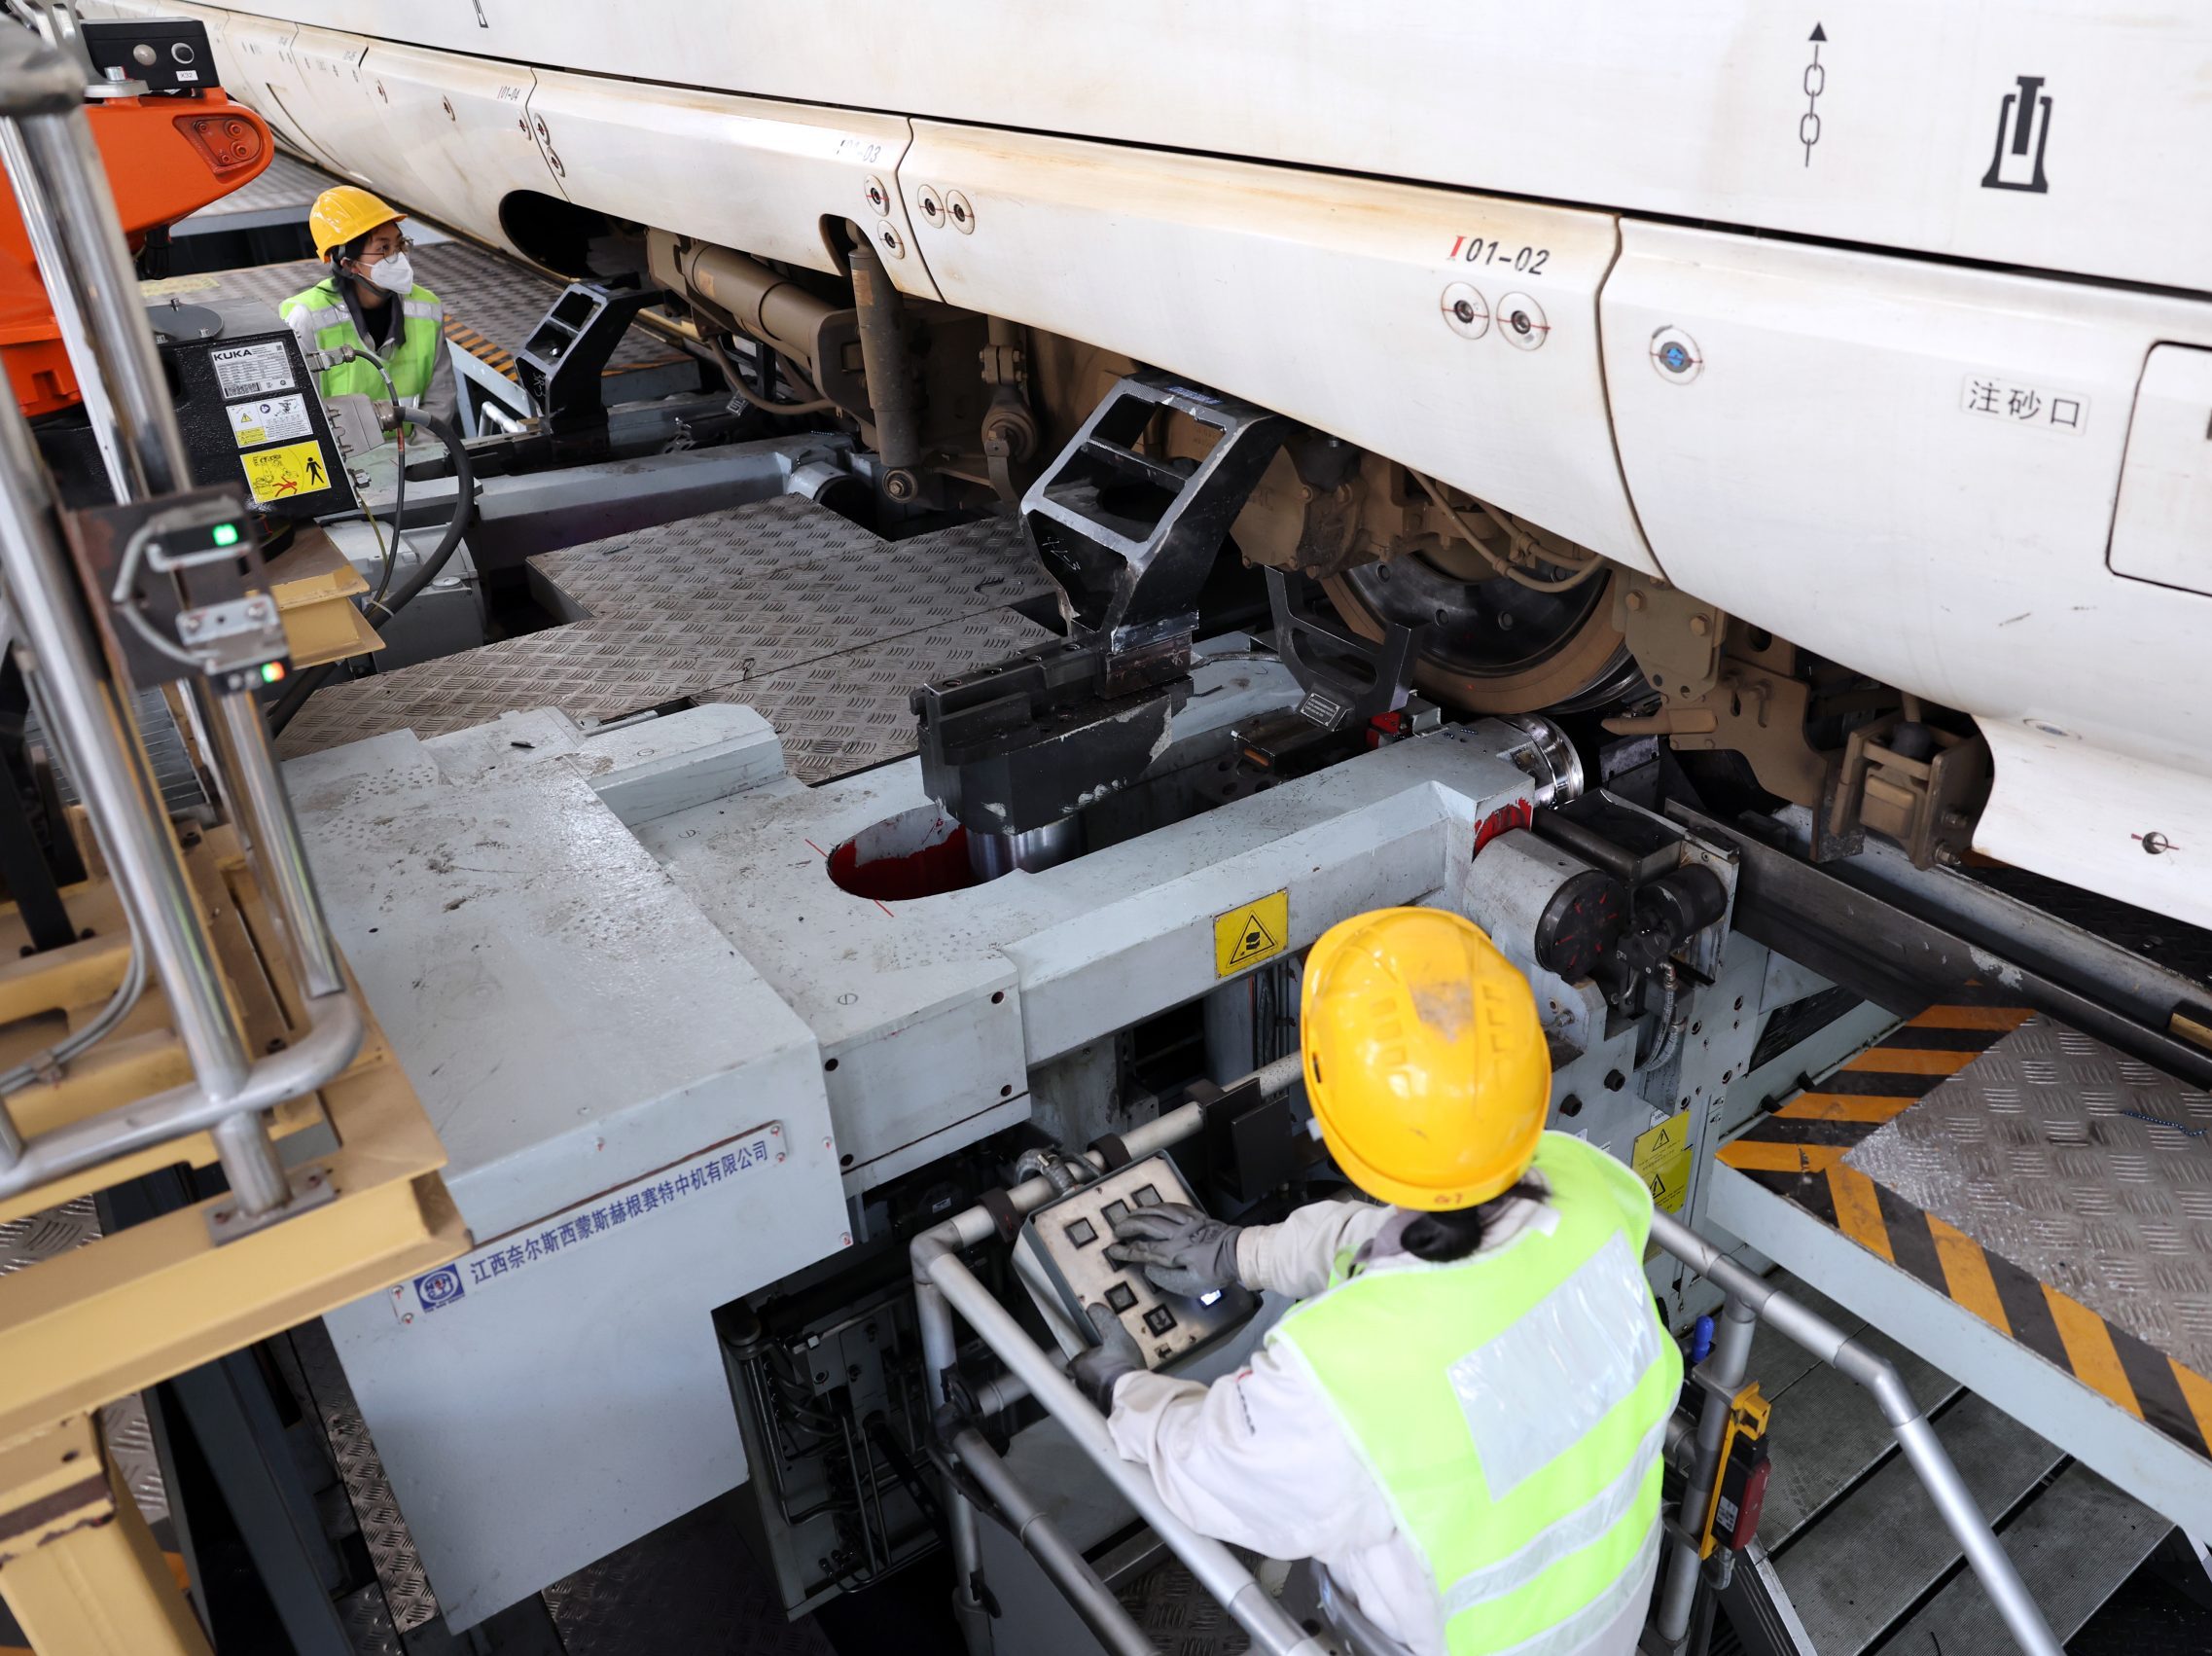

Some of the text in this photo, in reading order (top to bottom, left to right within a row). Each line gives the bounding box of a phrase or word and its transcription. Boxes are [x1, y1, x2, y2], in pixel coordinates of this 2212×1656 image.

[213, 349, 253, 361] KUKA
[1969, 380, 2080, 428] 注砂口
[470, 1140, 769, 1285] 江西奈尔斯西蒙斯赫根赛特中机有限公司
